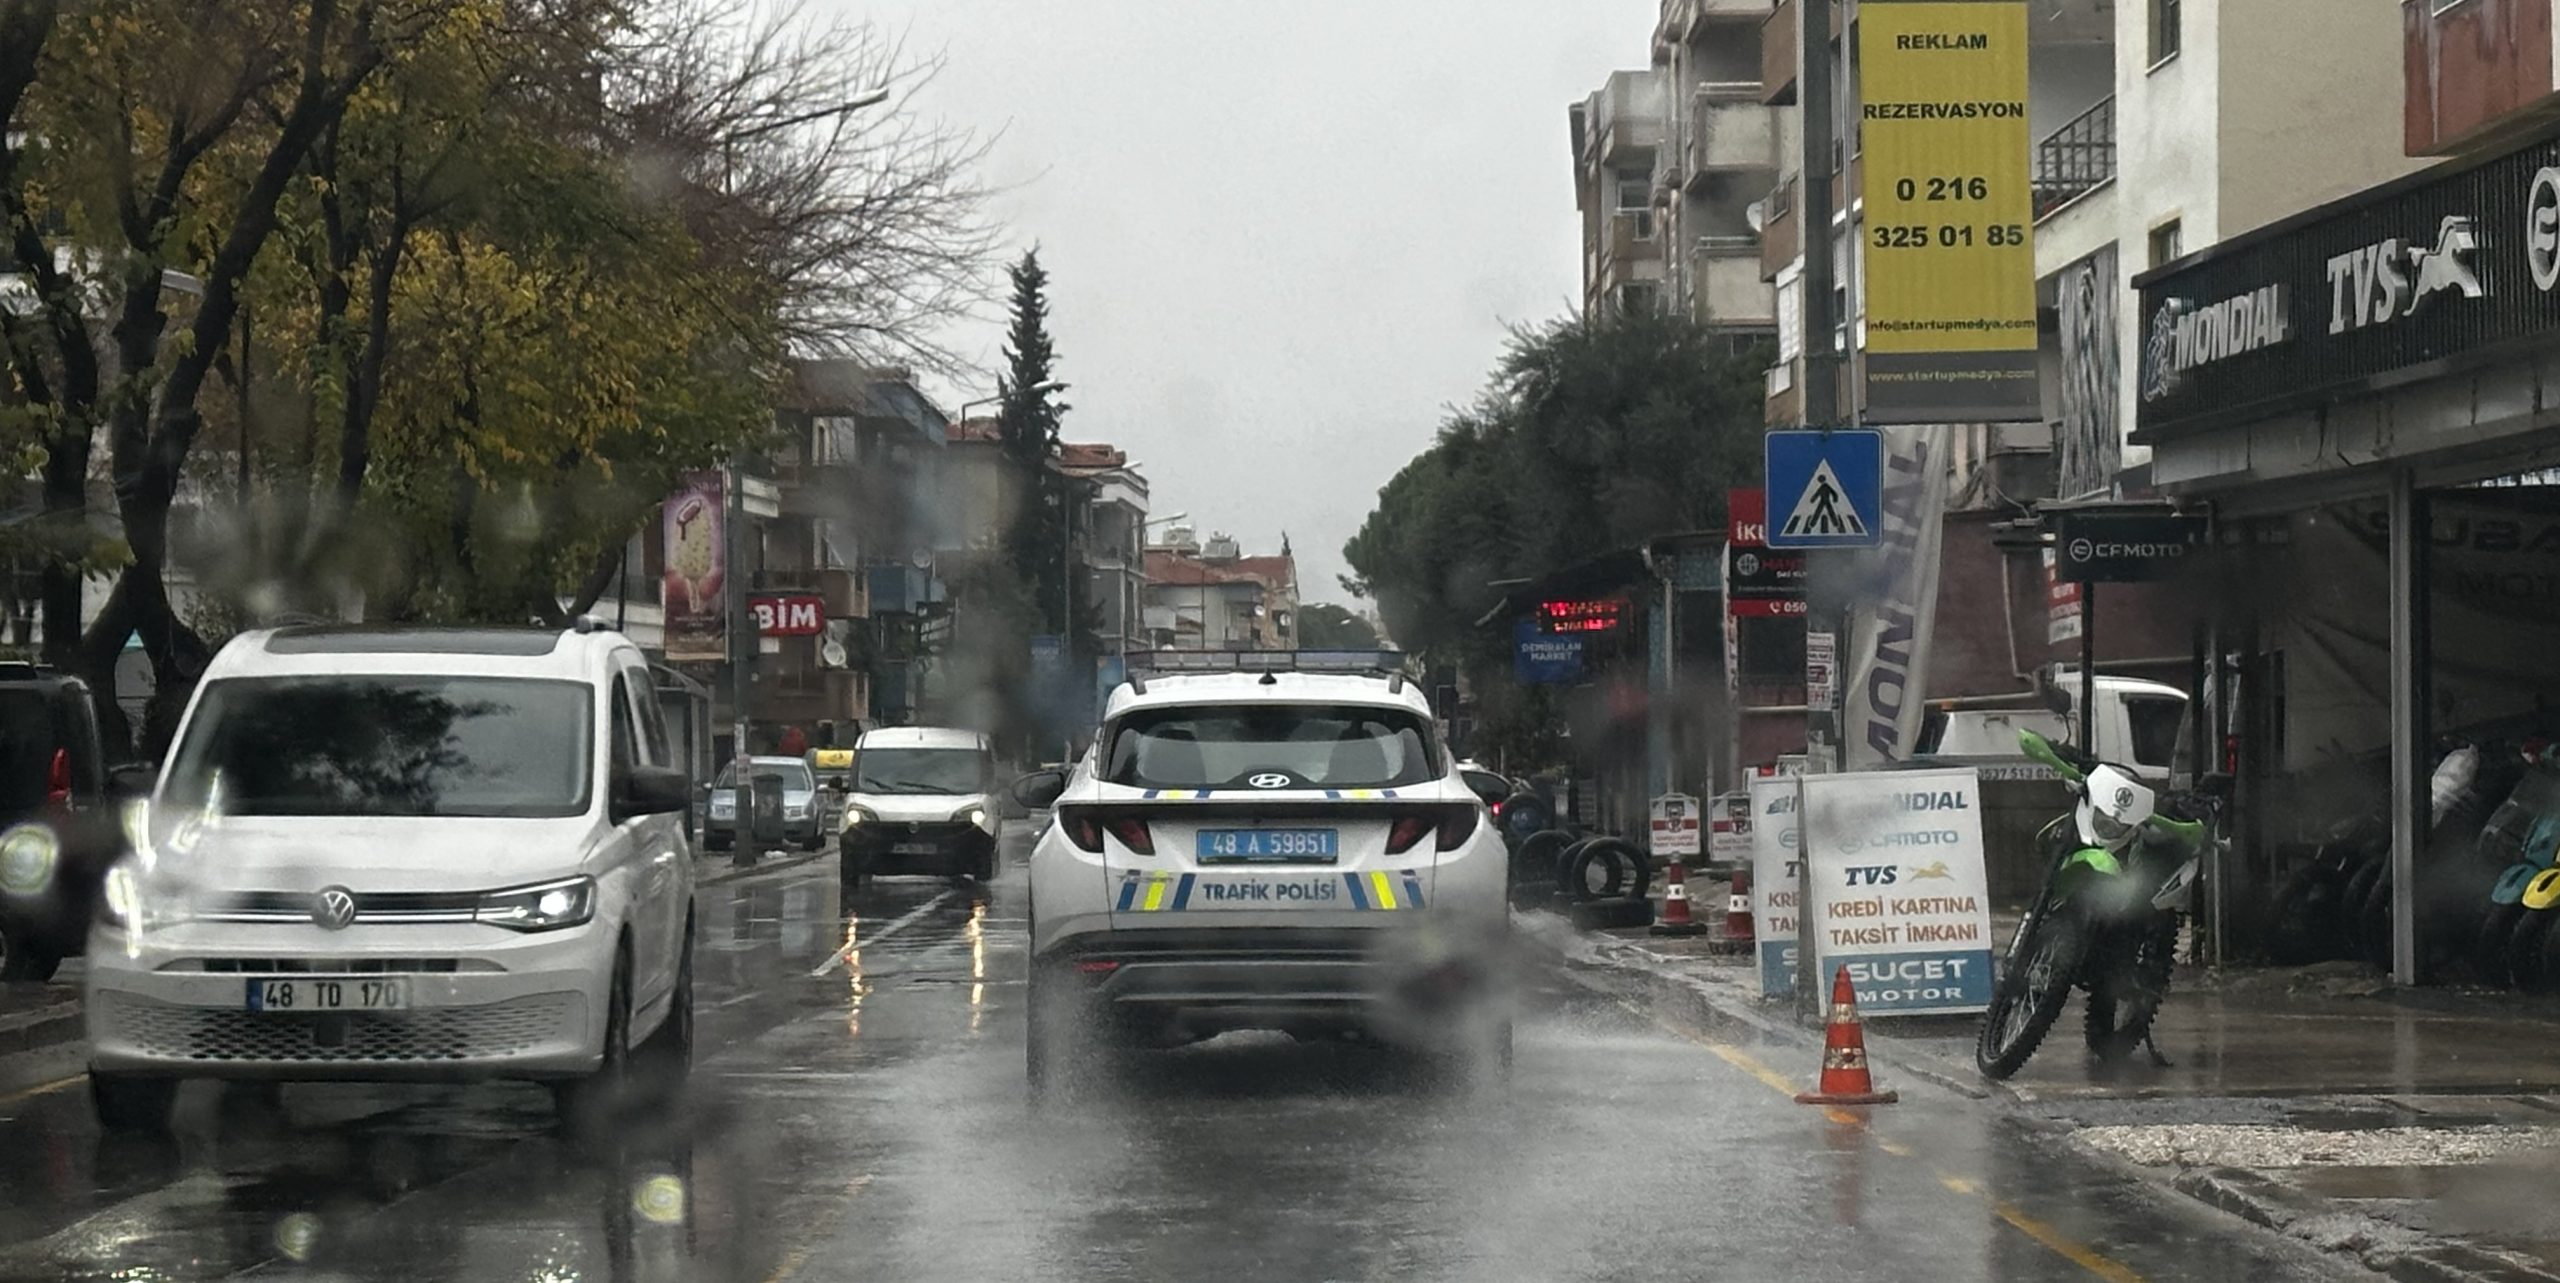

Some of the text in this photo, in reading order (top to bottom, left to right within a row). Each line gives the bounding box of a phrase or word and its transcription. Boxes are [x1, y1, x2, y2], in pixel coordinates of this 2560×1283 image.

[1896, 34, 1988, 50] REKLAM
[1863, 102, 2024, 119] REZERVASYON
[1896, 177, 1987, 201] 0 216
[1873, 224, 2024, 248] 325 01 85
[2175, 238, 2399, 371] MONDIAL TVS
[1866, 318, 2036, 332] info@startupmedya.com
[1868, 368, 2036, 384] www.startupmedya.com
[2095, 544, 2184, 557] CFMOTO
[754, 598, 817, 630] BİM
[1530, 651, 1573, 661] MARKET
[1213, 833, 1326, 854] 48 A 59851
[1845, 865, 1897, 886] TVS
[1203, 878, 1337, 901] TRAFİK POLİSİ
[1828, 896, 1978, 919] KREDİ KARTINA
[1830, 922, 1978, 946] TAKSİT İMKANI
[1846, 958, 1968, 985] SUÇET
[265, 982, 397, 1008] 48 TD 170
[1855, 987, 1963, 1003] MOTOR
